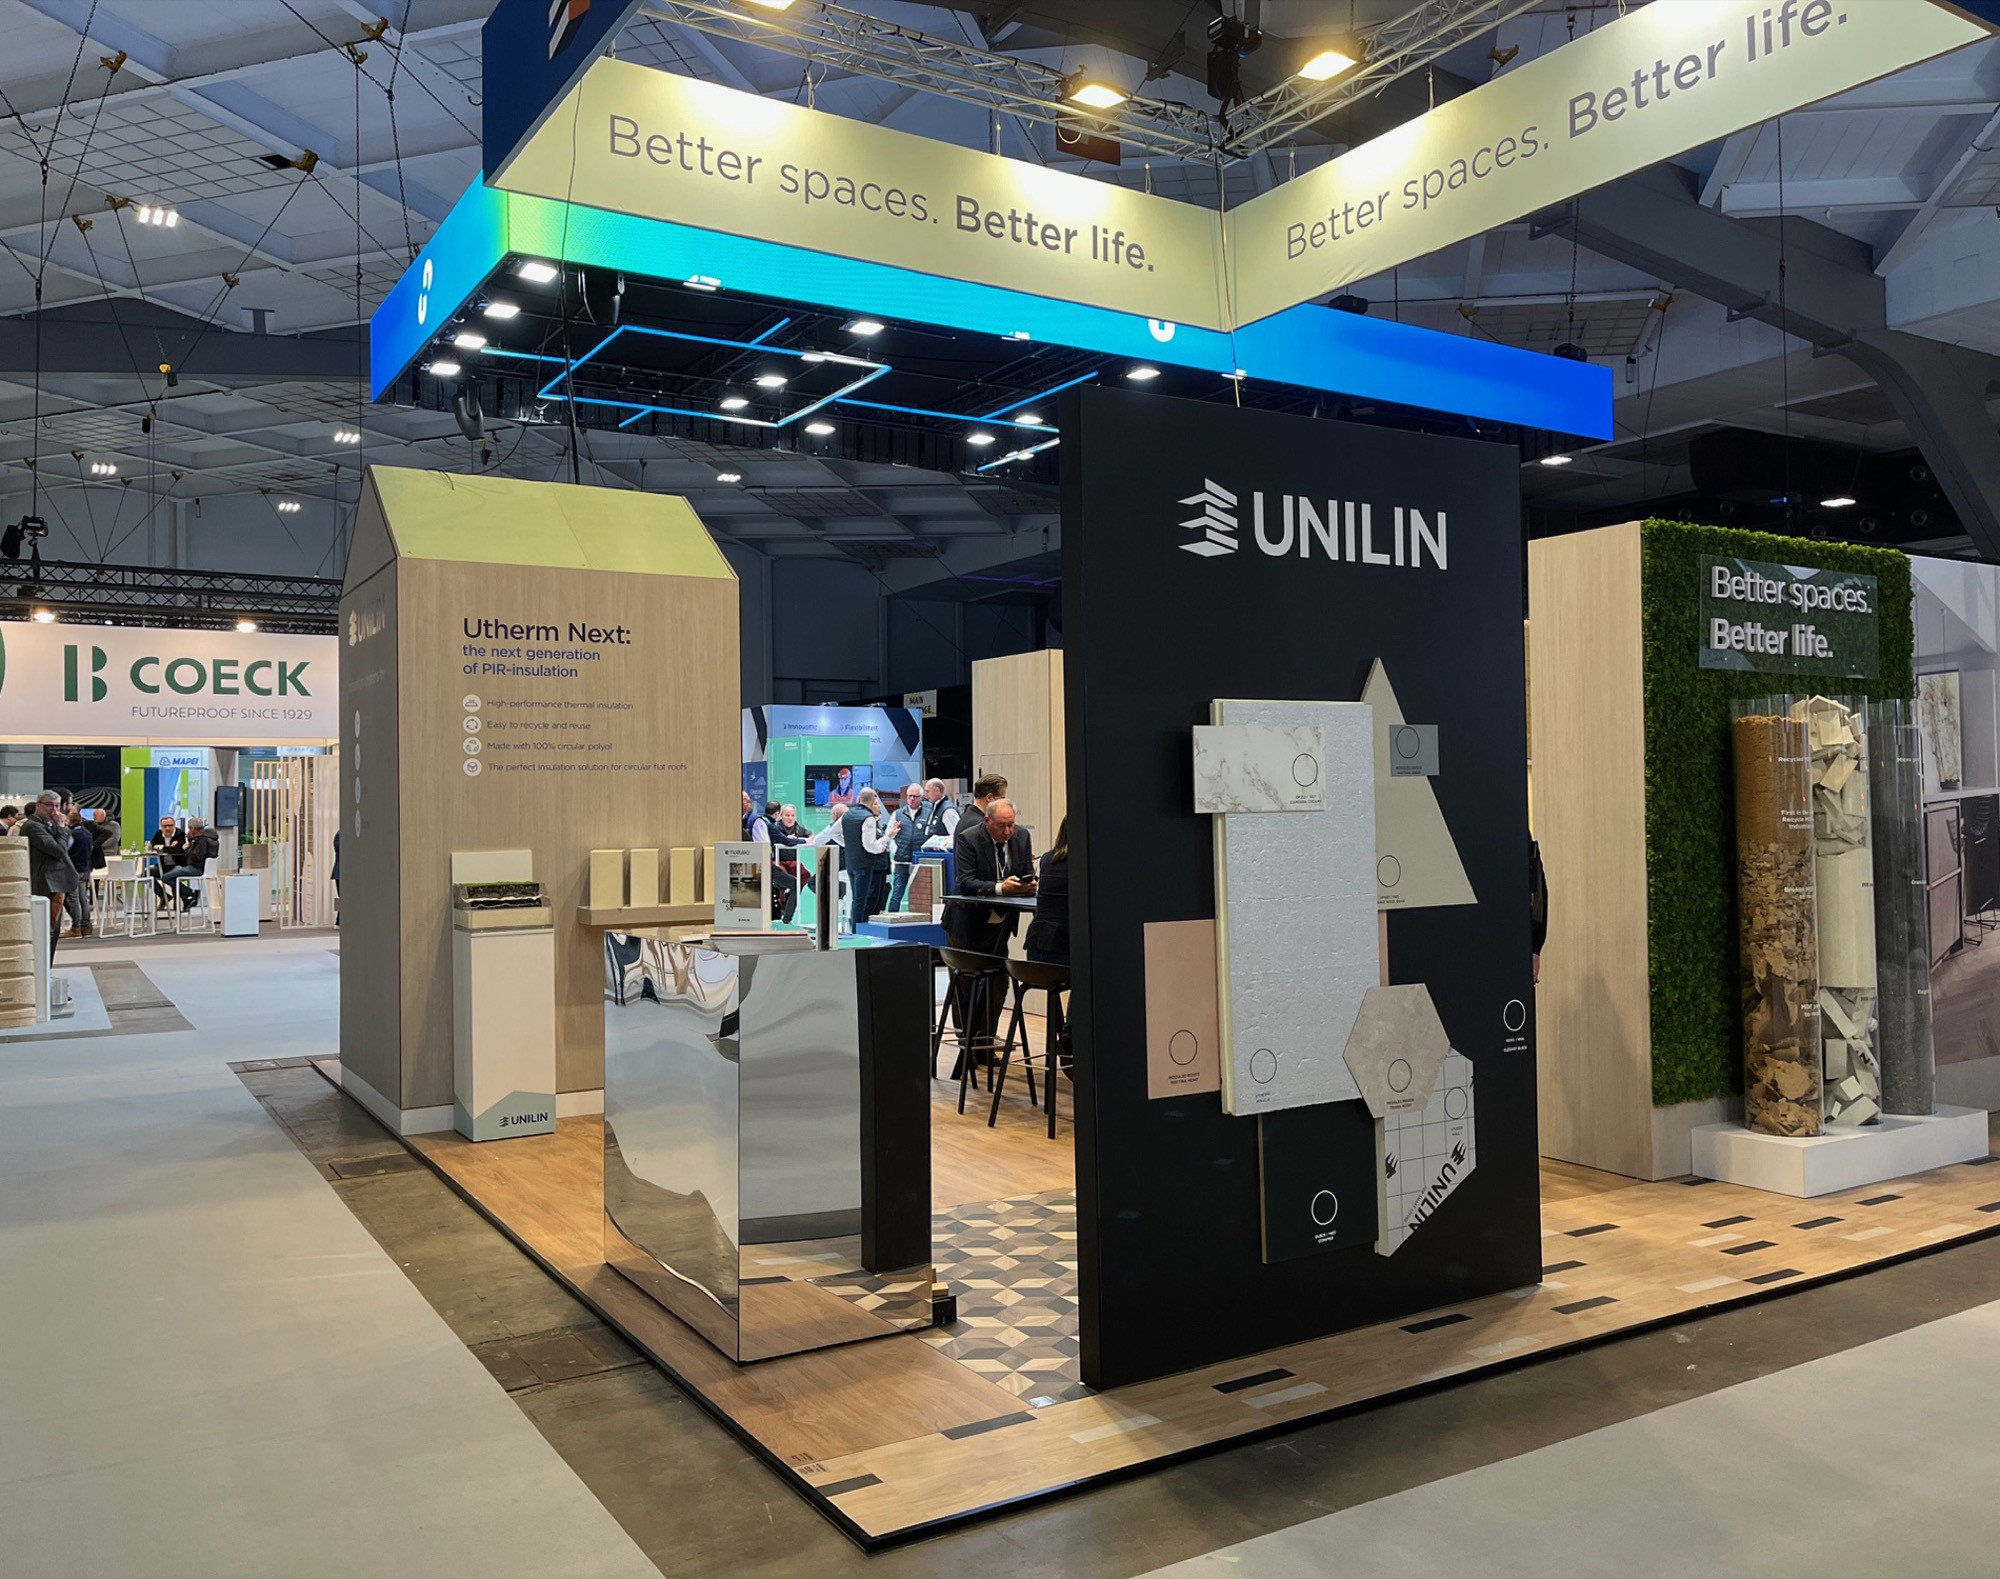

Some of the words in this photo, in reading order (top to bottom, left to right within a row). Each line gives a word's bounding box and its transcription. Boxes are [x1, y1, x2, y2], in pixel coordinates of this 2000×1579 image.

[1286, 190, 1390, 260] Better
[1402, 126, 1549, 210] spaces.
[1569, 39, 1725, 139] Better
[1746, 0, 1847, 62] life.
[610, 114, 762, 184] Better
[779, 163, 938, 224] spaces.
[956, 195, 1078, 254] Better
[1092, 225, 1154, 272] life.
[1253, 491, 1447, 570] UNILIN
[1711, 565, 1786, 604] Better
[1789, 582, 1872, 613] spaces.
[463, 618, 559, 642] Utherm
[568, 622, 631, 645] Next:
[1710, 618, 1788, 654] Better
[1791, 623, 1834, 658] life.
[463, 644, 486, 657] the
[491, 646, 522, 658] next
[526, 648, 601, 661] generation
[130, 656, 312, 697] COECK
[462, 662, 478, 675] of
[482, 663, 578, 678] PIR-insulation
[132, 706, 238, 719] FUTUREPROOF
[241, 708, 279, 719] SINCE
[282, 709, 312, 720] 1929
[487, 700, 562, 709] High-performance
[564, 701, 595, 709] thermal
[597, 702, 634, 710] insulation
[487, 721, 507, 730] Easy
[520, 721, 549, 731] recycle
[552, 721, 567, 729] and
[487, 742, 511, 750] Made
[513, 742, 531, 750] with
[533, 742, 556, 750] 100%
[557, 742, 585, 750] circular
[588, 742, 613, 752] polyol
[172, 757, 199, 766] MAPEI
[488, 763, 503, 771] The
[505, 763, 536, 773] perfect
[538, 762, 576, 771] insulation
[578, 762, 609, 771] solution
[611, 763, 621, 771] for
[623, 763, 651, 771] circular
[653, 763, 666, 771] flat
[668, 763, 687, 771] roofs
[511, 1112, 548, 1125] UNILIN
